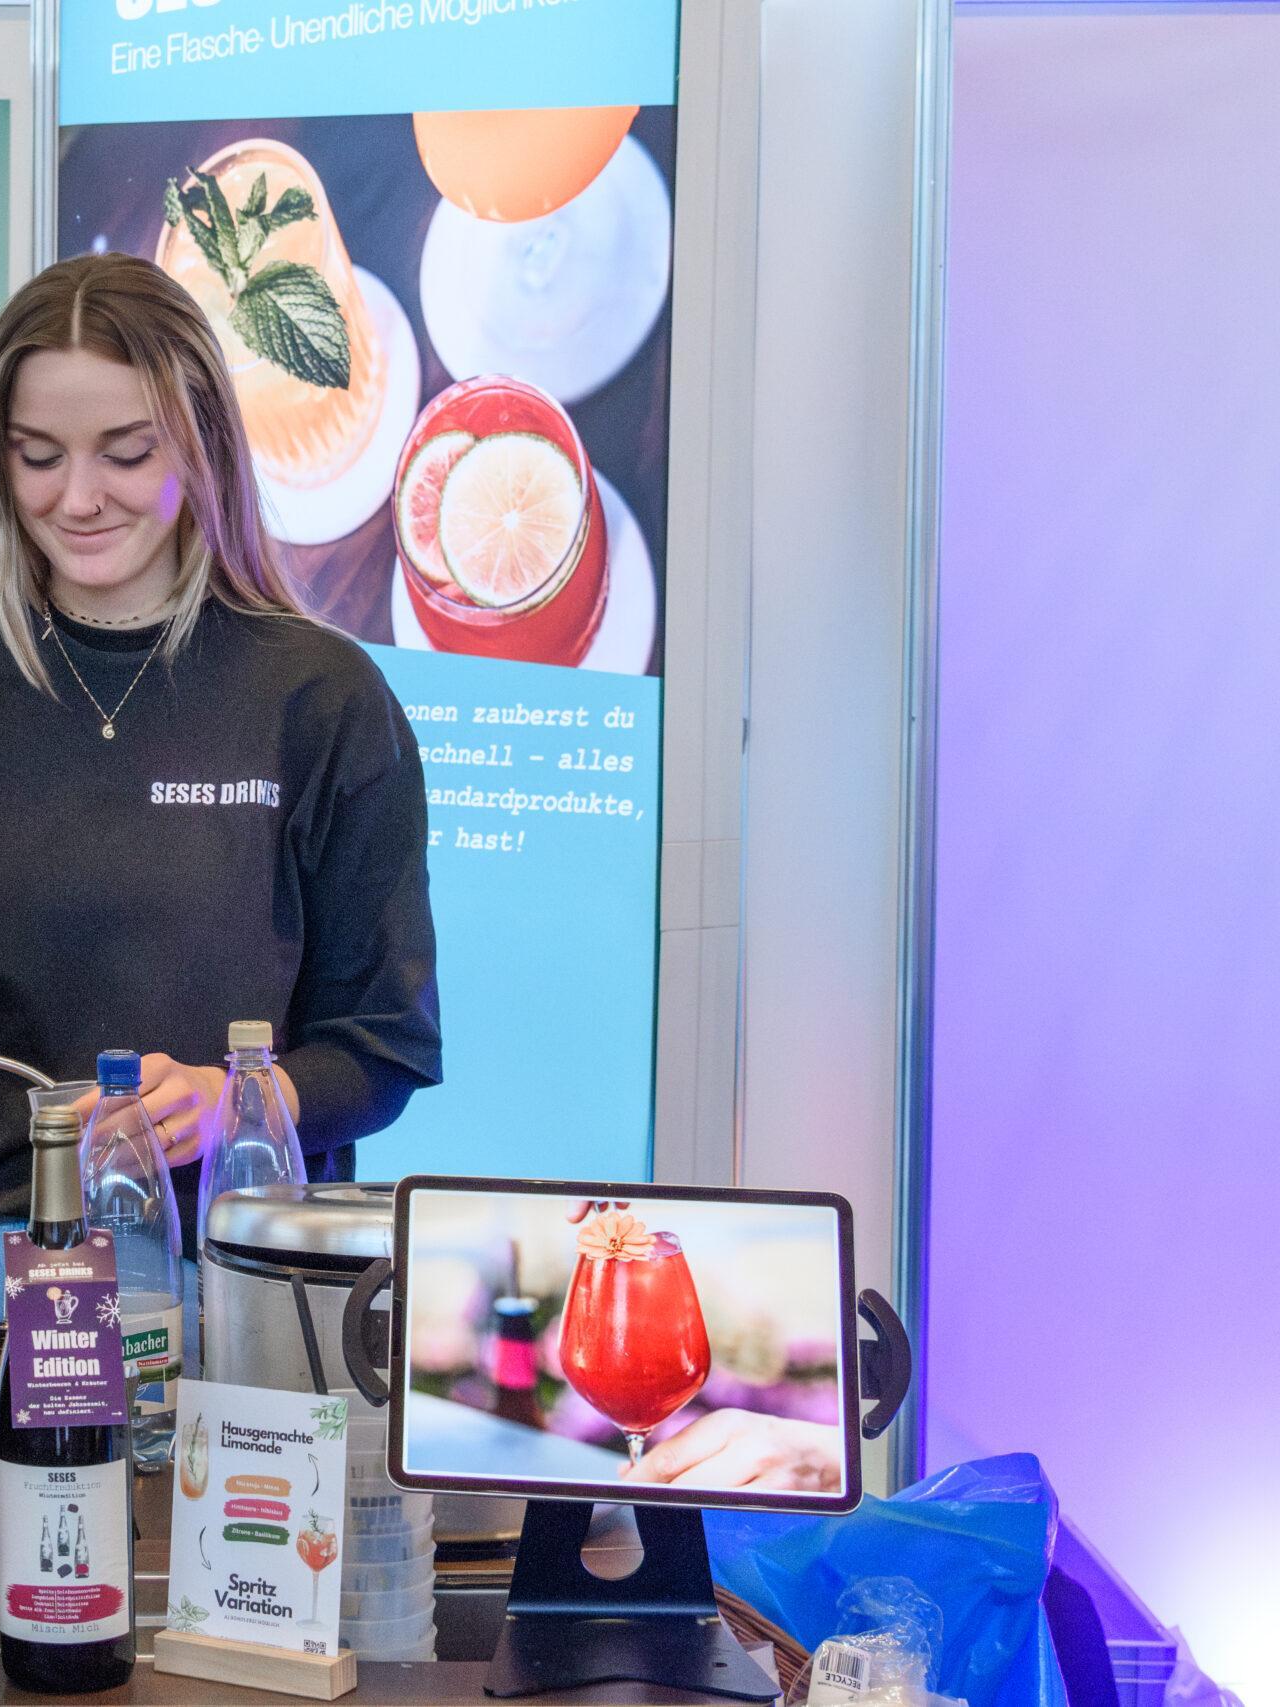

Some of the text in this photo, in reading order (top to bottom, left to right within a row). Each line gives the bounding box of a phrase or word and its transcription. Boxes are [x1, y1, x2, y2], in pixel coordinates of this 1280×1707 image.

[111, 42, 161, 75] Eine
[270, 0, 414, 49] Unendliche
[403, 704, 635, 728] onen zauberst du
[418, 743, 634, 773] schnell alles
[150, 779, 280, 808] SESES DRINKS
[426, 786, 644, 821] andardprodukte,
[455, 826, 525, 853] hast!
[28, 1266, 94, 1279] SESES DRINKS
[31, 1330, 99, 1351] Winter
[33, 1356, 101, 1378] Edition
[220, 1434, 283, 1455] Limonade
[221, 1420, 314, 1445] Hausgemachte
[47, 1472, 76, 1482] SESES
[231, 1527, 251, 1537] Zitrone
[228, 1573, 277, 1598] Spritz
[215, 1589, 293, 1619] Variation
[31, 1623, 100, 1634] Misch Mich
[825, 1673, 861, 1690] RECYCLE
